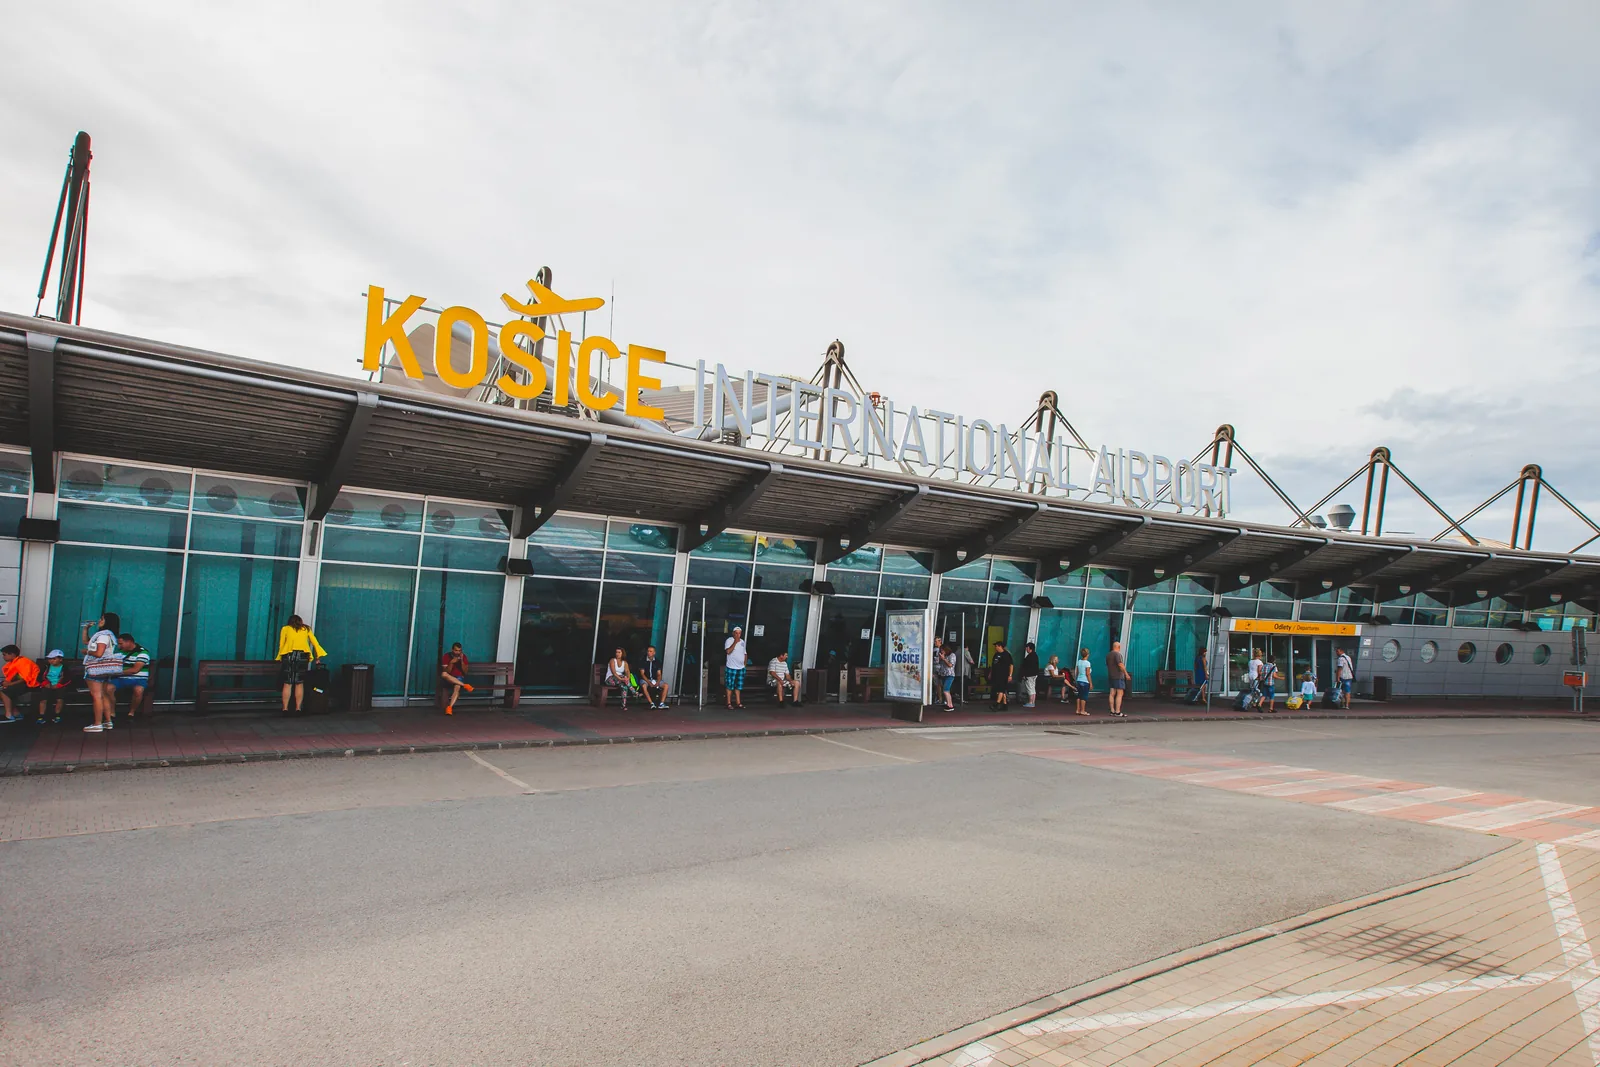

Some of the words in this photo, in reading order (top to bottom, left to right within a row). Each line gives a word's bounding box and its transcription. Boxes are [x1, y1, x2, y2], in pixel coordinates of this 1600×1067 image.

[693, 359, 1078, 491] INTERNATIONAL
[1089, 444, 1237, 514] AIRPORT
[1274, 623, 1291, 631] Odlety
[891, 651, 920, 664] KOŠICE
